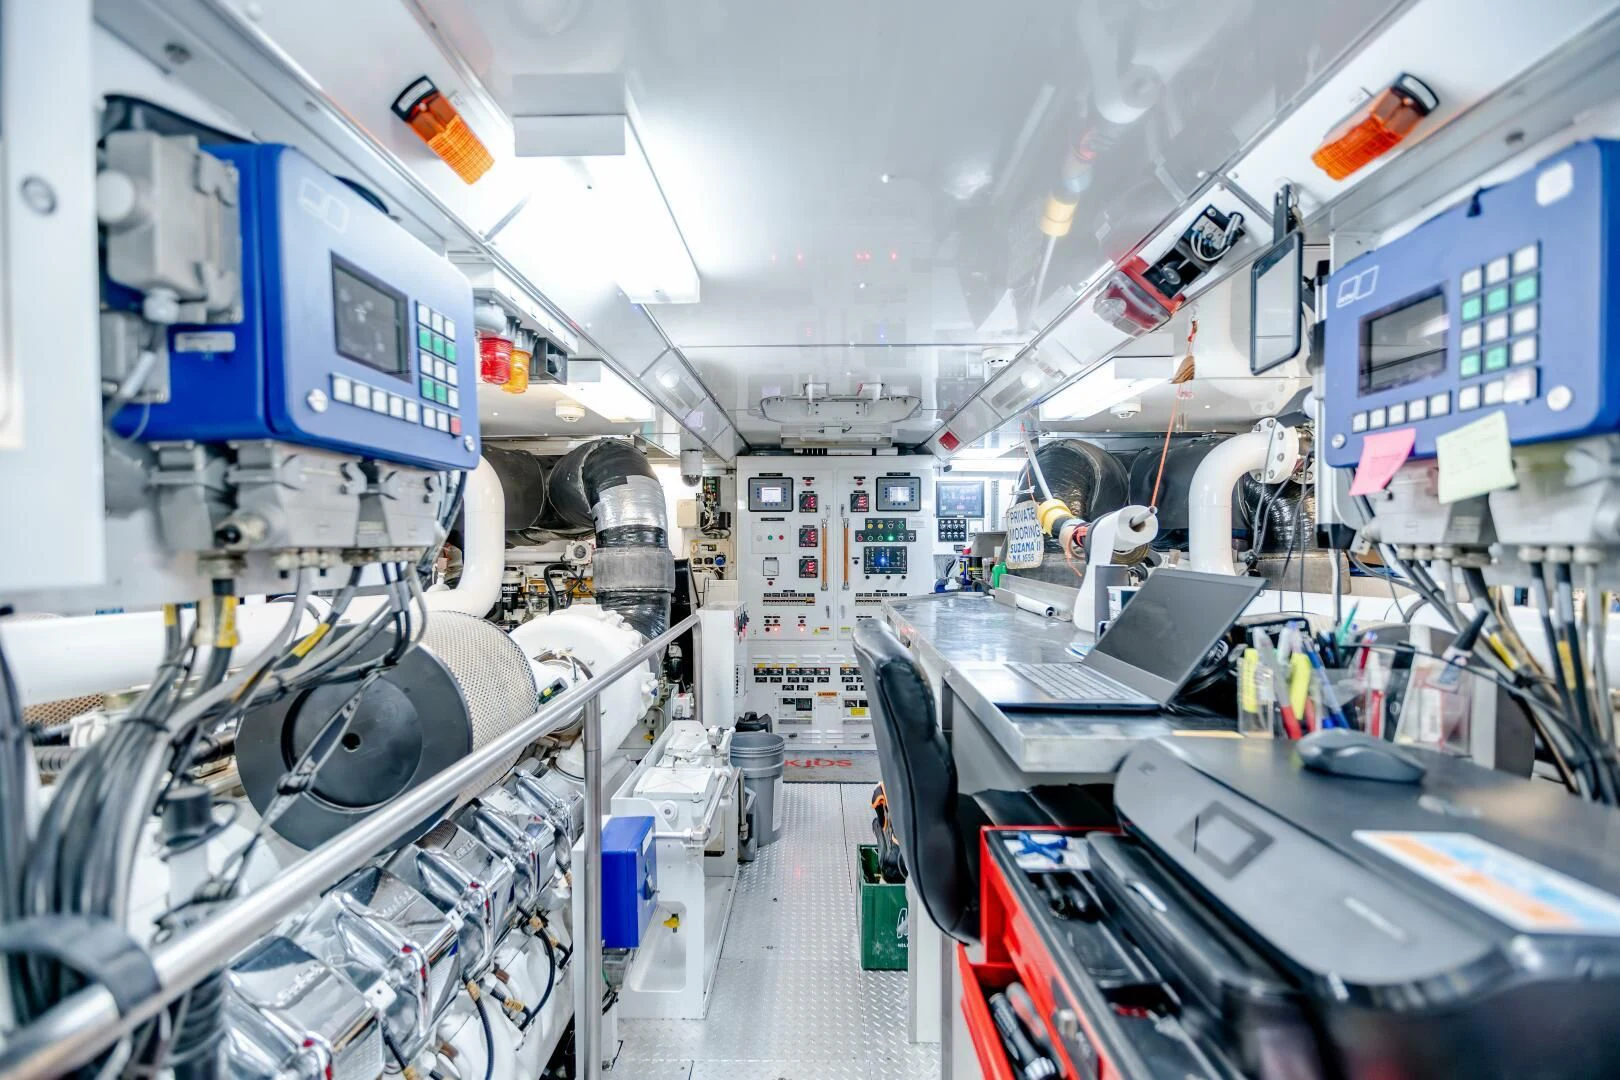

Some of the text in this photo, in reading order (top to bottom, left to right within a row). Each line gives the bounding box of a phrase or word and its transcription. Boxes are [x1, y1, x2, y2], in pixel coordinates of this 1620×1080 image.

[1010, 507, 1035, 524] PRIVATE
[1009, 524, 1041, 541] MOORING
[1010, 542, 1034, 554] SUZANA
